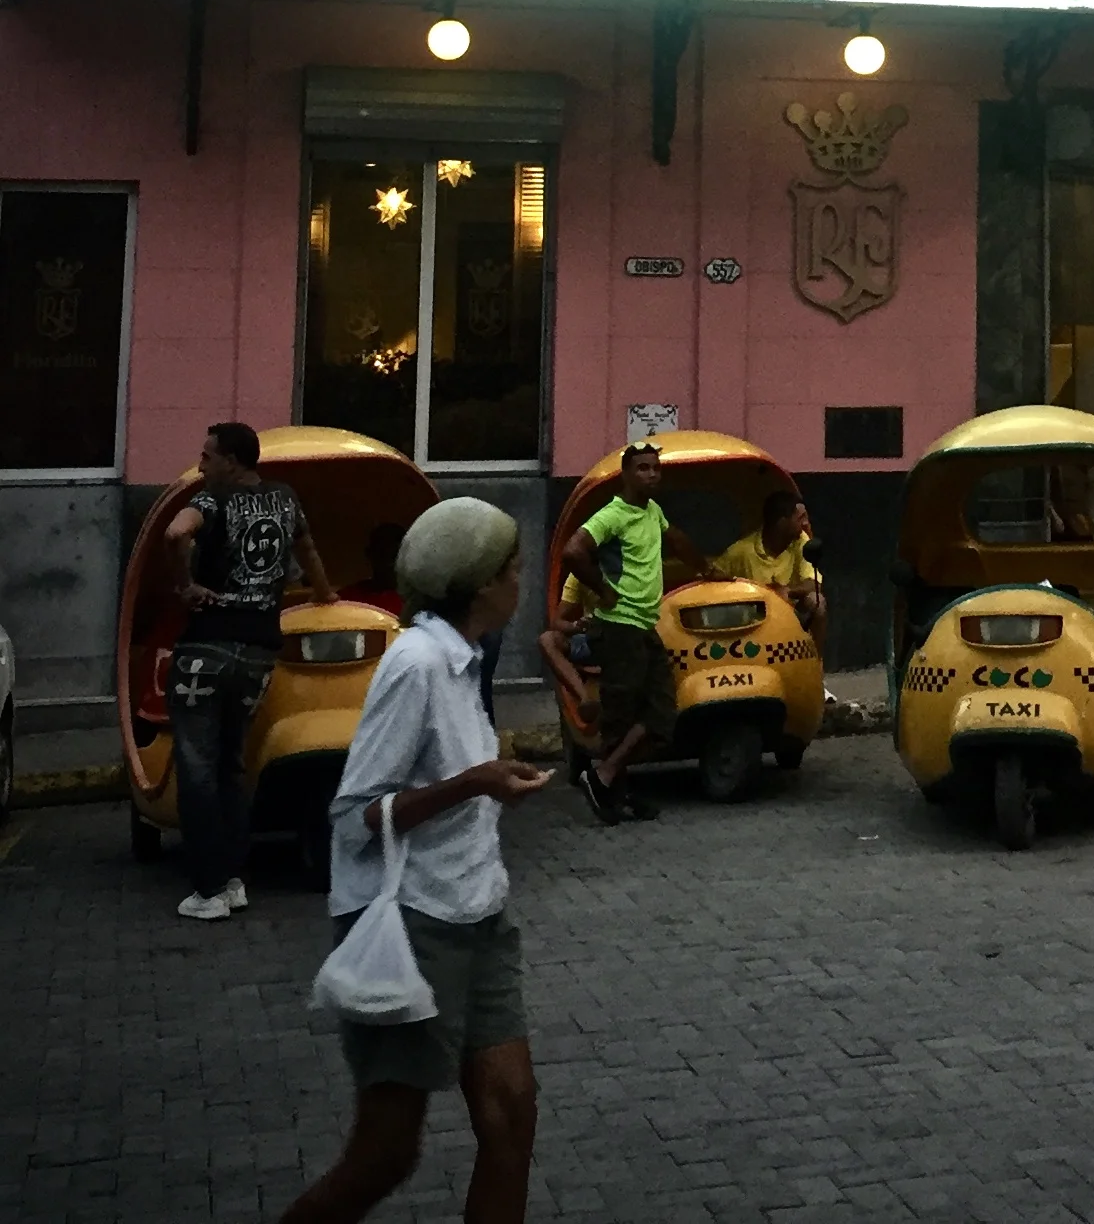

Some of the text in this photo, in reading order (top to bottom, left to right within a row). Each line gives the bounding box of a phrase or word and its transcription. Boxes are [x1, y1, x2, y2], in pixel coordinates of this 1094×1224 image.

[712, 262, 736, 278] 557
[693, 639, 762, 661] COCO
[706, 673, 754, 689] TAXI
[972, 664, 1054, 690] COCO
[985, 700, 1041, 719] TAXI
